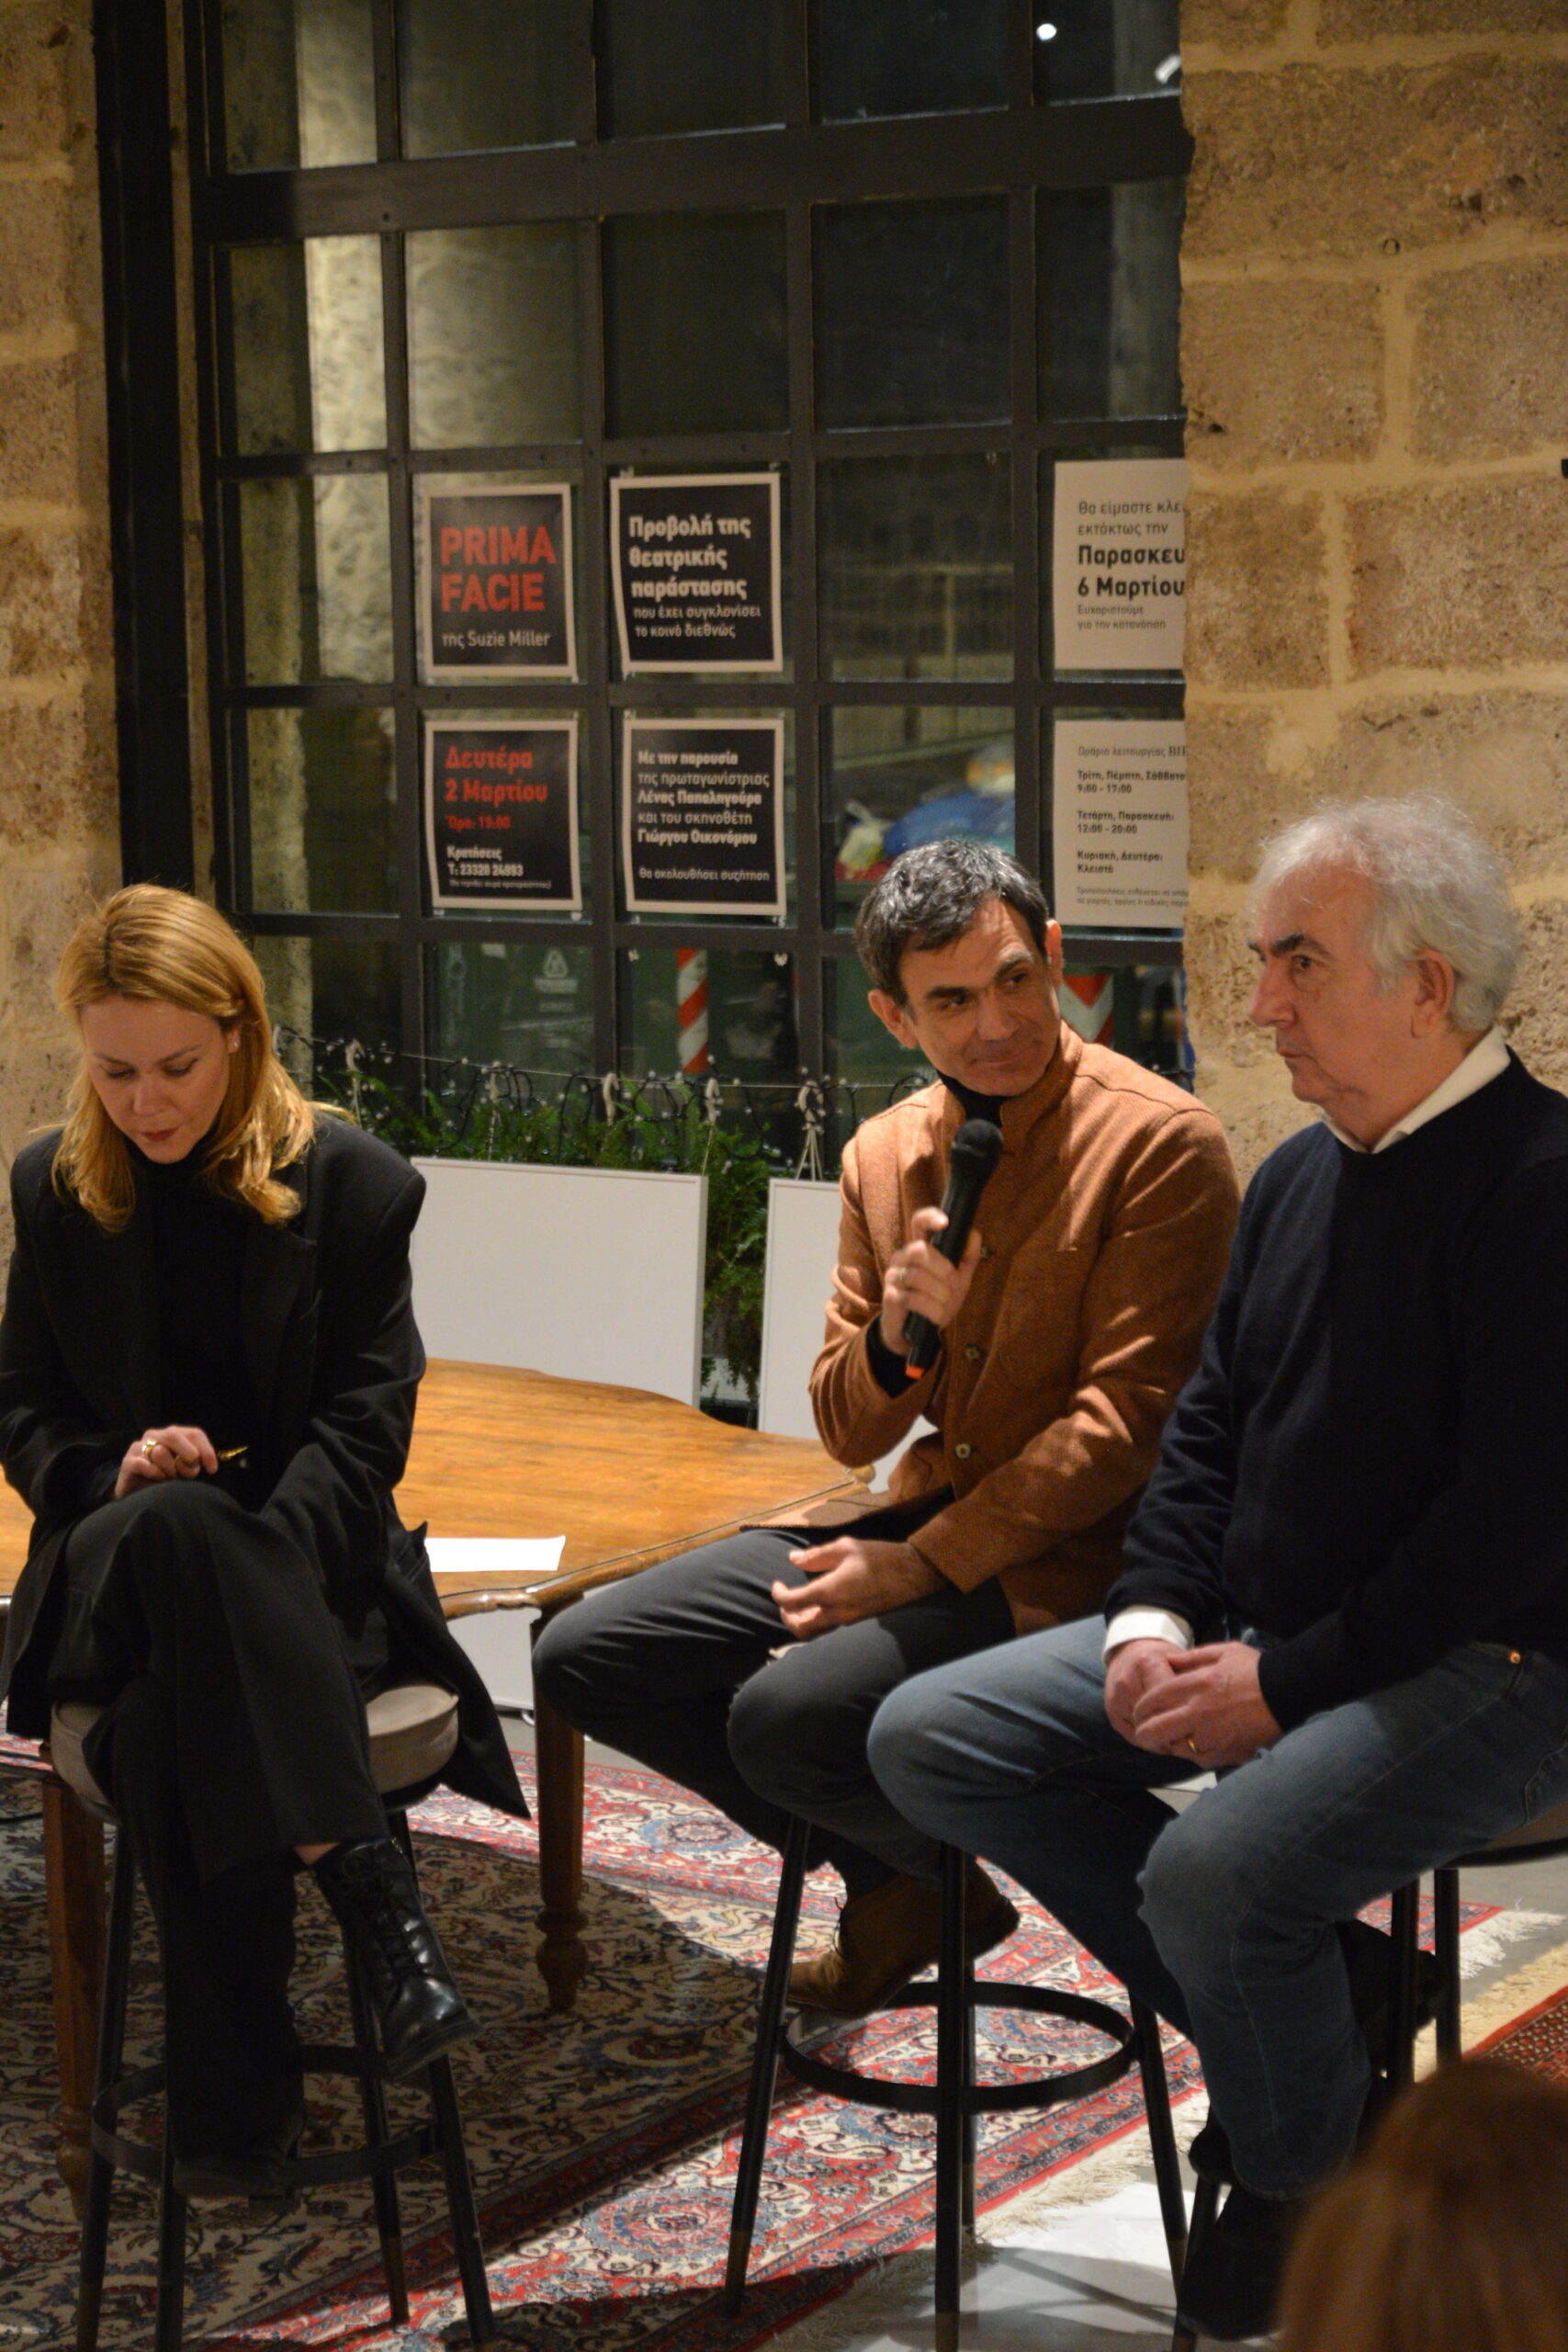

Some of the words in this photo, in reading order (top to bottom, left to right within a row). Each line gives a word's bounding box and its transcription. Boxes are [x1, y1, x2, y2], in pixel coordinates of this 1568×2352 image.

[1078, 501, 1096, 514] Θα
[1100, 501, 1153, 517] είμαστε
[629, 514, 714, 542] Προβολή
[716, 518, 751, 539] της
[1077, 522, 1142, 537] εκτάκτως
[1145, 523, 1168, 534] την
[441, 525, 557, 565] PRIMA
[629, 544, 728, 571] θεατρικής
[1078, 545, 1185, 570] Παρασκευ
[441, 571, 545, 612] FACIE
[631, 575, 748, 603] παράστασης
[1077, 577, 1089, 596] 6
[1097, 575, 1185, 601] Μαρτίου
[634, 606, 656, 618] που
[659, 605, 684, 618] έχει
[686, 604, 761, 619] συγκλονίσει
[636, 626, 648, 638] το
[650, 624, 682, 638] κοινό
[685, 622, 736, 639] διεθνώς
[1095, 620, 1111, 629] την
[442, 632, 465, 650] της
[468, 629, 505, 647] Suzie
[508, 629, 550, 647] Miller
[446, 744, 534, 775] Δευτέρα
[638, 752, 655, 764] Με
[657, 752, 678, 764] την
[681, 751, 739, 768] παρουσία
[638, 773, 658, 786] της
[446, 780, 457, 801] 2
[463, 778, 548, 808] Μαρτίου
[1077, 785, 1097, 794] 9:00
[1107, 784, 1132, 794] 17:00
[637, 790, 675, 807] Λένας
[677, 790, 762, 808] Παπαληγούρα
[638, 813, 658, 824] και
[660, 812, 682, 824] του
[684, 811, 752, 825] σκηνοθέτη
[1077, 824, 1102, 833] 12:00
[1111, 824, 1137, 834] 20:00
[638, 830, 688, 847] Γιώργου
[691, 830, 758, 848] Οικονόμου
